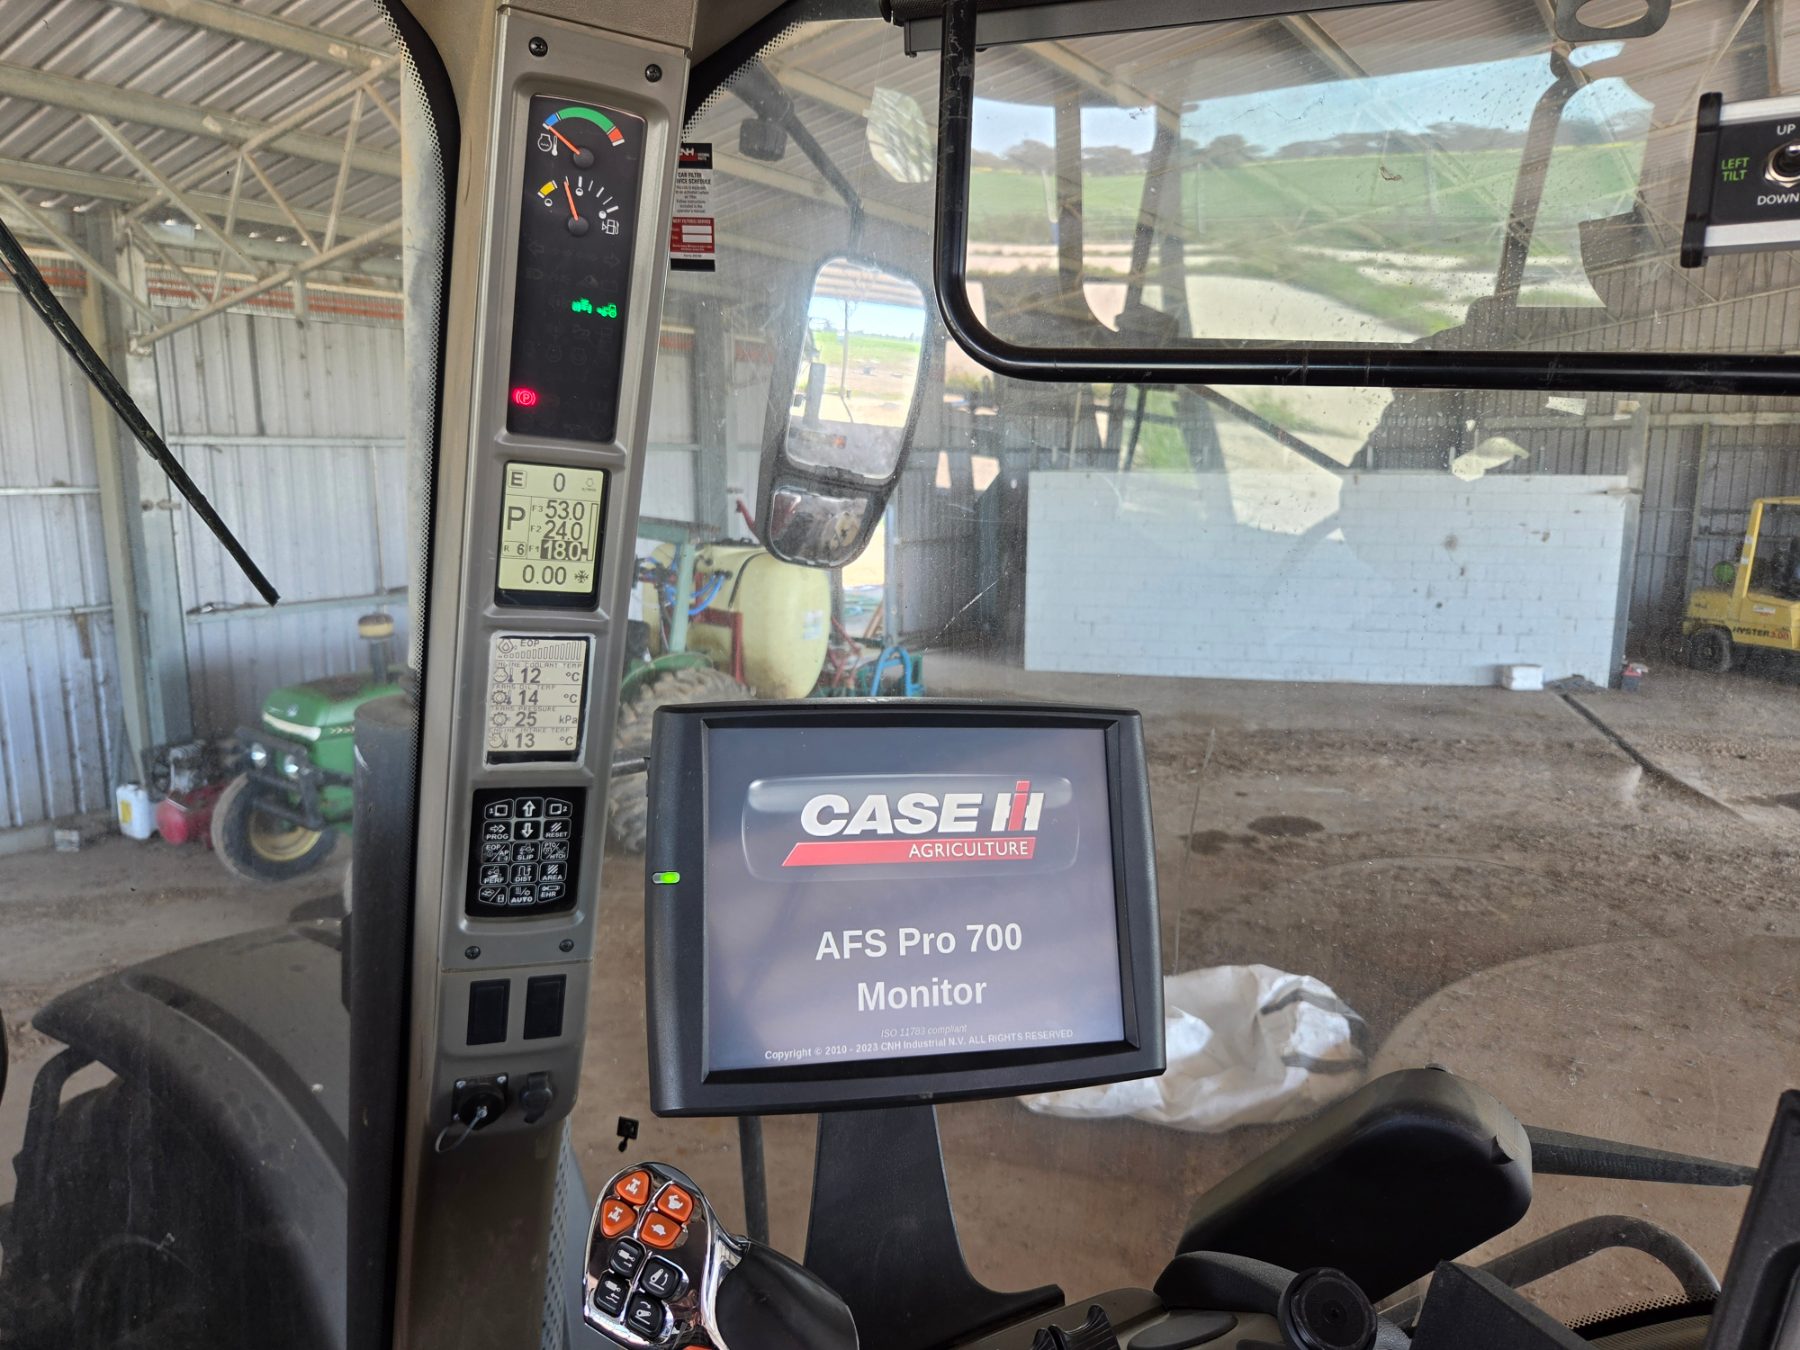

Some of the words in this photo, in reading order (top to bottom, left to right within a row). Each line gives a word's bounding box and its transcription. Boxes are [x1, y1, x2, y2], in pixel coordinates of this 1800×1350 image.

[1777, 124, 1796, 136] UP
[1721, 157, 1749, 170] LEFT
[1722, 169, 1748, 182] TILT
[1757, 193, 1800, 206] DOWN
[511, 471, 523, 487] E
[553, 472, 566, 492] 0
[507, 506, 526, 531] P
[532, 504, 543, 513] F3
[545, 500, 585, 521] 53.0
[530, 525, 542, 533] F2
[543, 520, 583, 541] 24.0
[516, 543, 525, 555] 6
[529, 545, 539, 553] F1
[543, 540, 581, 561] 18.0
[522, 564, 567, 585] 0.00
[520, 639, 540, 647] EOP
[520, 667, 542, 684] 12
[565, 671, 580, 682] °C
[518, 689, 539, 706] 14
[563, 693, 578, 704] °C
[515, 711, 537, 727] 25
[559, 715, 578, 724] kPa
[515, 733, 535, 748] 13
[559, 736, 574, 746] °C
[801, 792, 983, 837] CASE
[908, 841, 1029, 859] AGRICULTURE
[815, 929, 888, 961] AFS
[899, 927, 956, 957] Pro
[966, 922, 1023, 953] 700
[857, 977, 988, 1012] Monitor
[880, 1028, 898, 1038] ISO
[900, 1027, 926, 1037] 11783
[928, 1024, 968, 1037] compliant
[764, 1048, 812, 1061] Copyright
[825, 1045, 847, 1055] 2010
[880, 1041, 901, 1051] CNH
[903, 1038, 946, 1049] Industrial
[949, 1037, 966, 1046] N.V.
[968, 1036, 986, 1044] ALL
[988, 1033, 1023, 1043] RIGHTS
[1024, 1029, 1074, 1040] RESERVED
